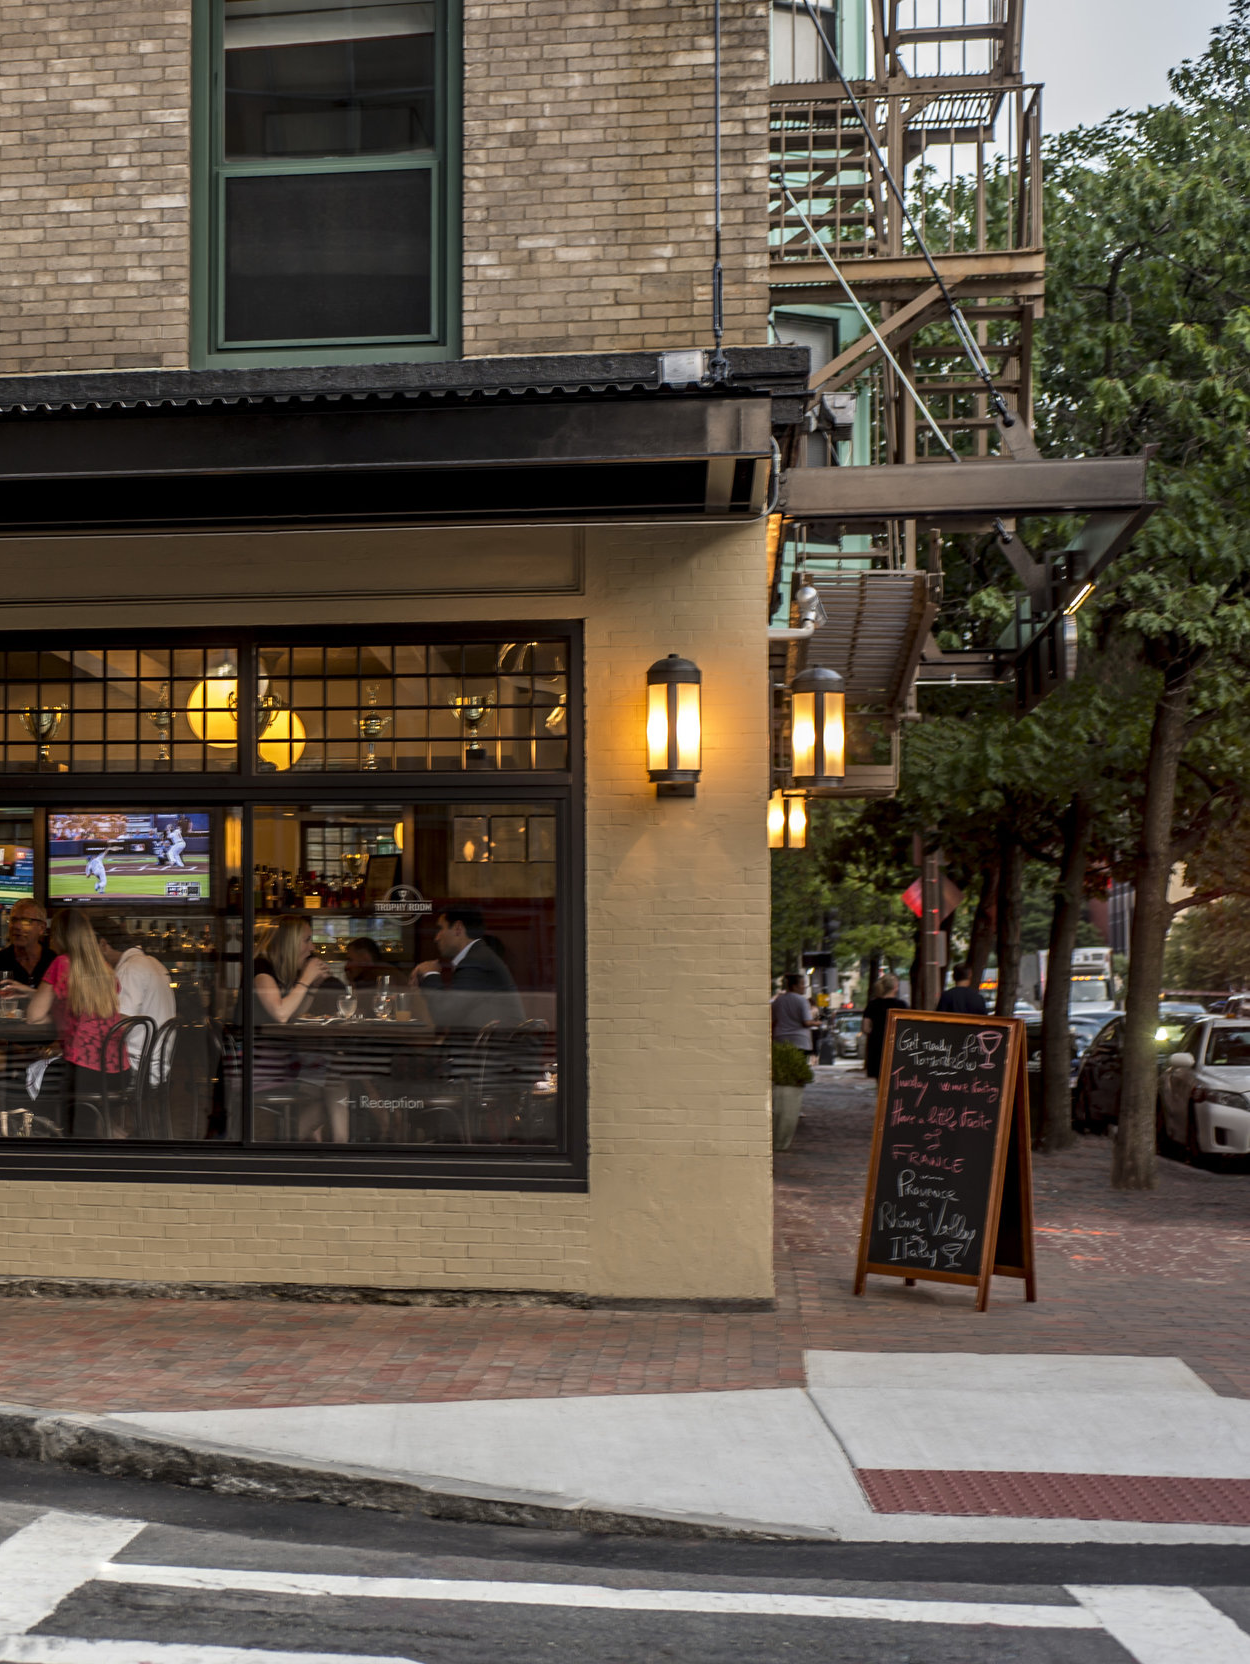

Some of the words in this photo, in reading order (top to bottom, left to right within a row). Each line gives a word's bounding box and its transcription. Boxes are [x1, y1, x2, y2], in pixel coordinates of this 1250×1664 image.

[375, 903, 406, 911] TROPHY
[408, 903, 432, 911] ROOM
[897, 1028, 919, 1051] Get
[360, 1095, 424, 1112] Reception
[891, 1099, 917, 1127] Have
[927, 1106, 958, 1131] little
[892, 1144, 966, 1173] FRANCE
[888, 1237, 938, 1267] Italy
